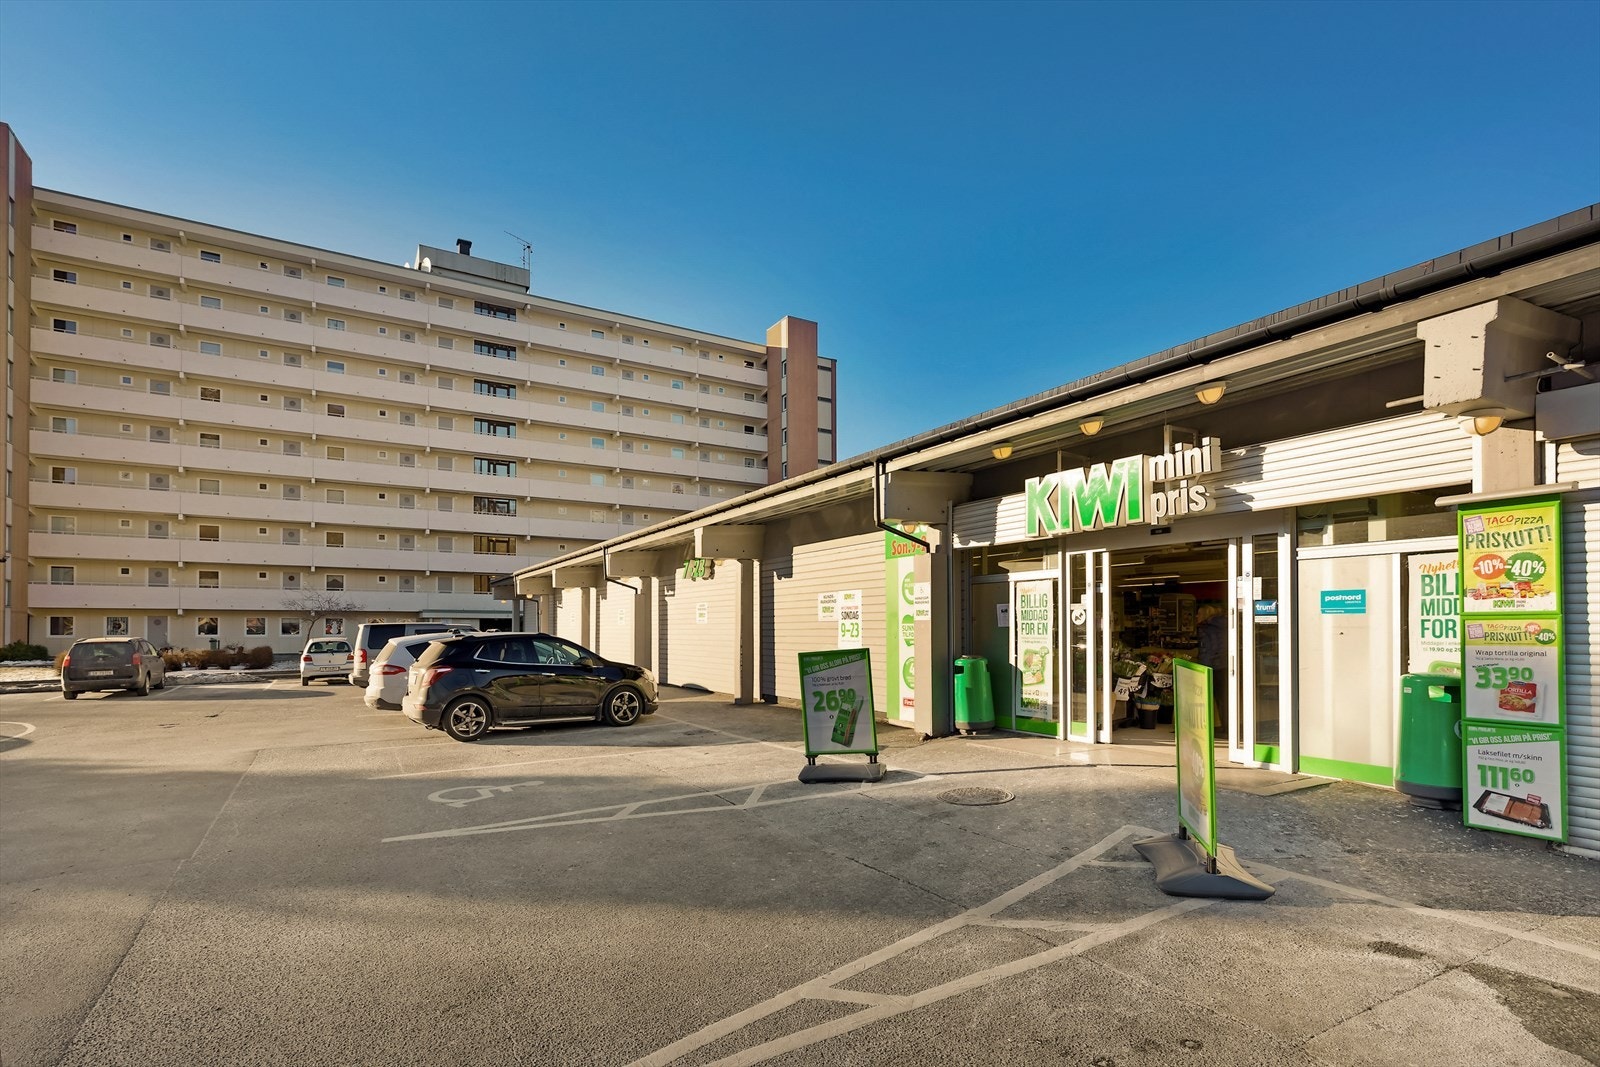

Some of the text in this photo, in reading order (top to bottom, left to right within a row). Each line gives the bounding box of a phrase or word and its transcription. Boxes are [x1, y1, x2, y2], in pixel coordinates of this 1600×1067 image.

[1150, 437, 1219, 481] mini
[1025, 454, 1147, 537] KIWI
[1151, 480, 1207, 525] pris
[1486, 515, 1514, 525] TACO
[1514, 516, 1544, 525] PIZZA
[1466, 525, 1552, 549] PRISKUTT!
[1473, 559, 1545, 577] -10% -40%
[1021, 593, 1048, 608] BILLIG
[1021, 609, 1048, 621] MIDDAG
[841, 622, 860, 638] 9-23
[1021, 622, 1048, 635] FOR EN
[1421, 619, 1457, 638] FOR
[1484, 631, 1532, 642] PRISKUTT!
[1523, 732, 1532, 741] PÅ
[1477, 749, 1511, 758] Laksefilet
[1512, 753, 1543, 761] m/skinn
